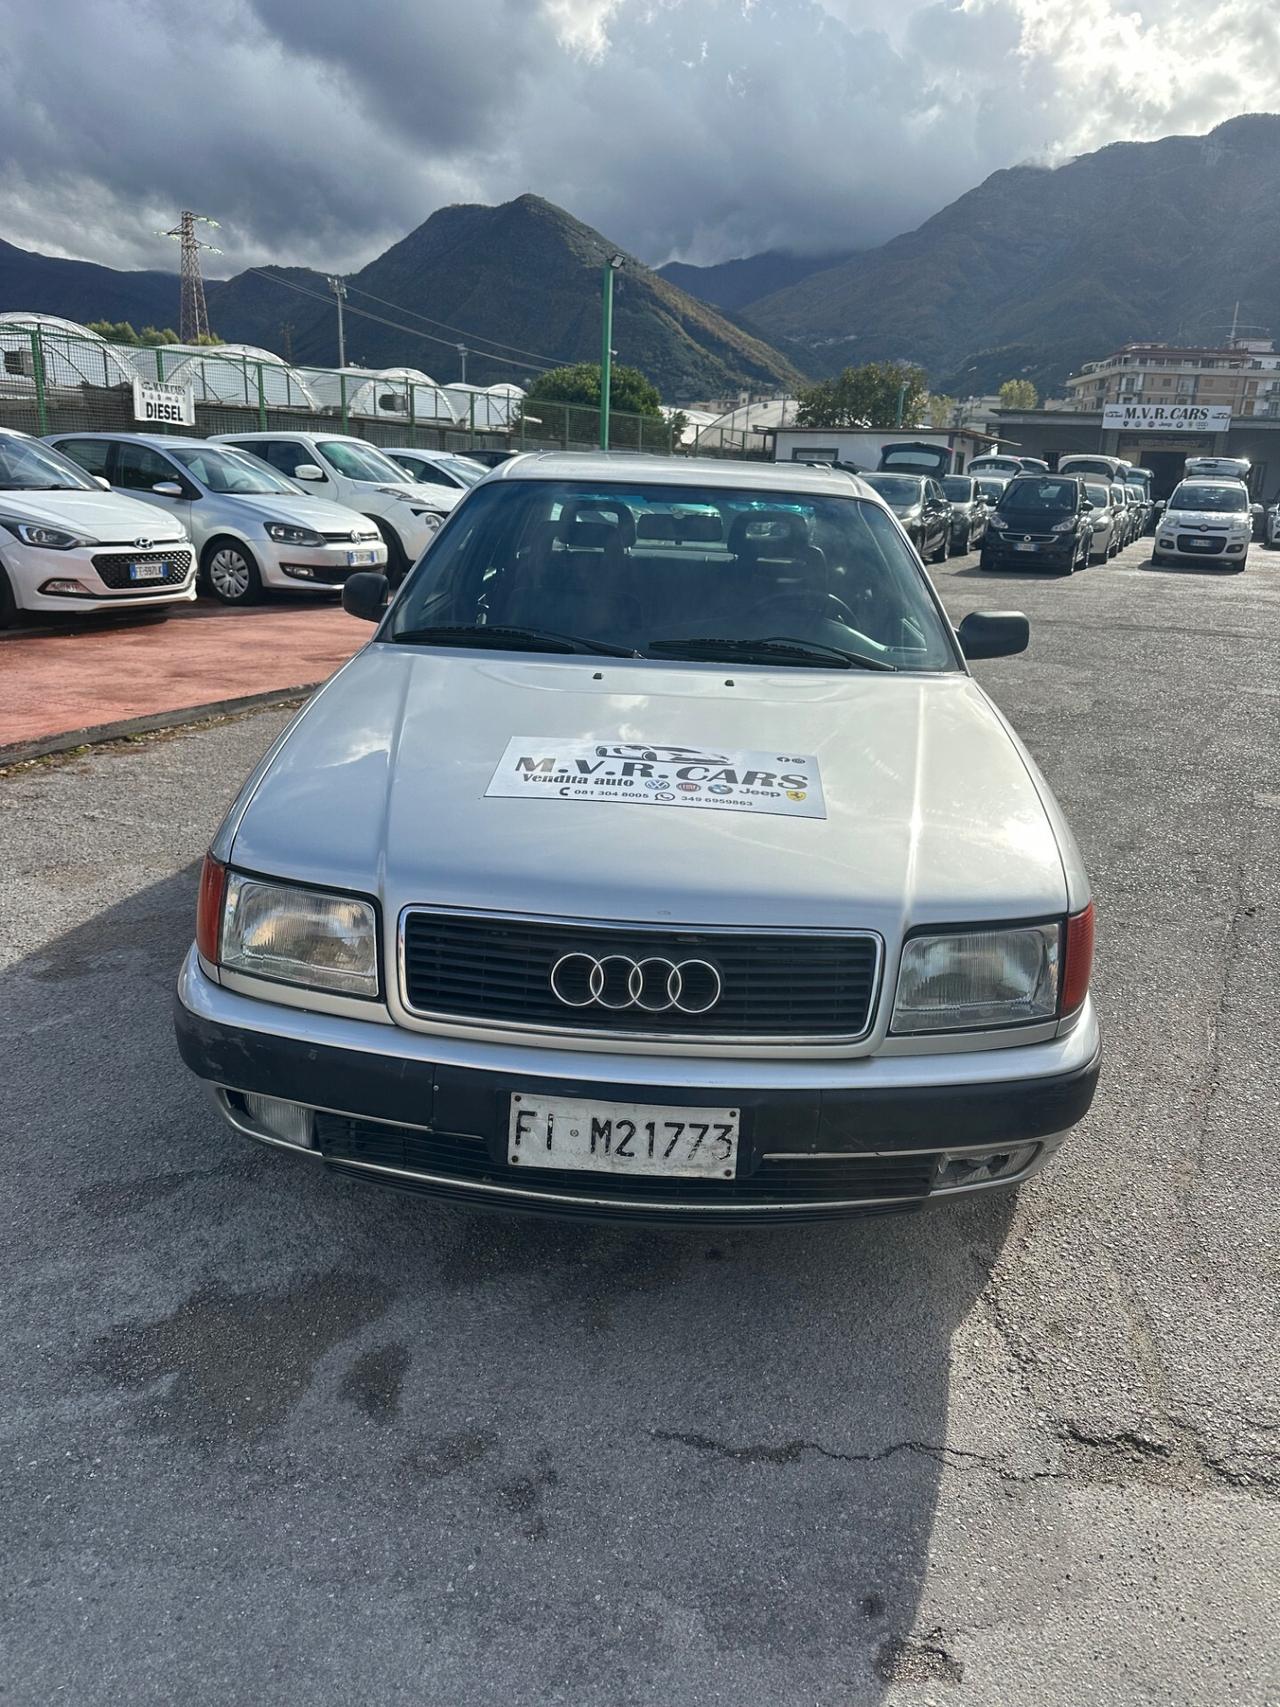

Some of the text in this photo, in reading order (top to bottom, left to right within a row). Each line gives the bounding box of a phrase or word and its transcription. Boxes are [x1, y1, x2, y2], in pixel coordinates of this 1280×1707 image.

[146, 401, 184, 422] DIESEL
[523, 773, 634, 787] Vendita auto
[739, 788, 781, 798] Jeep
[515, 1110, 734, 1160] FI M21773
